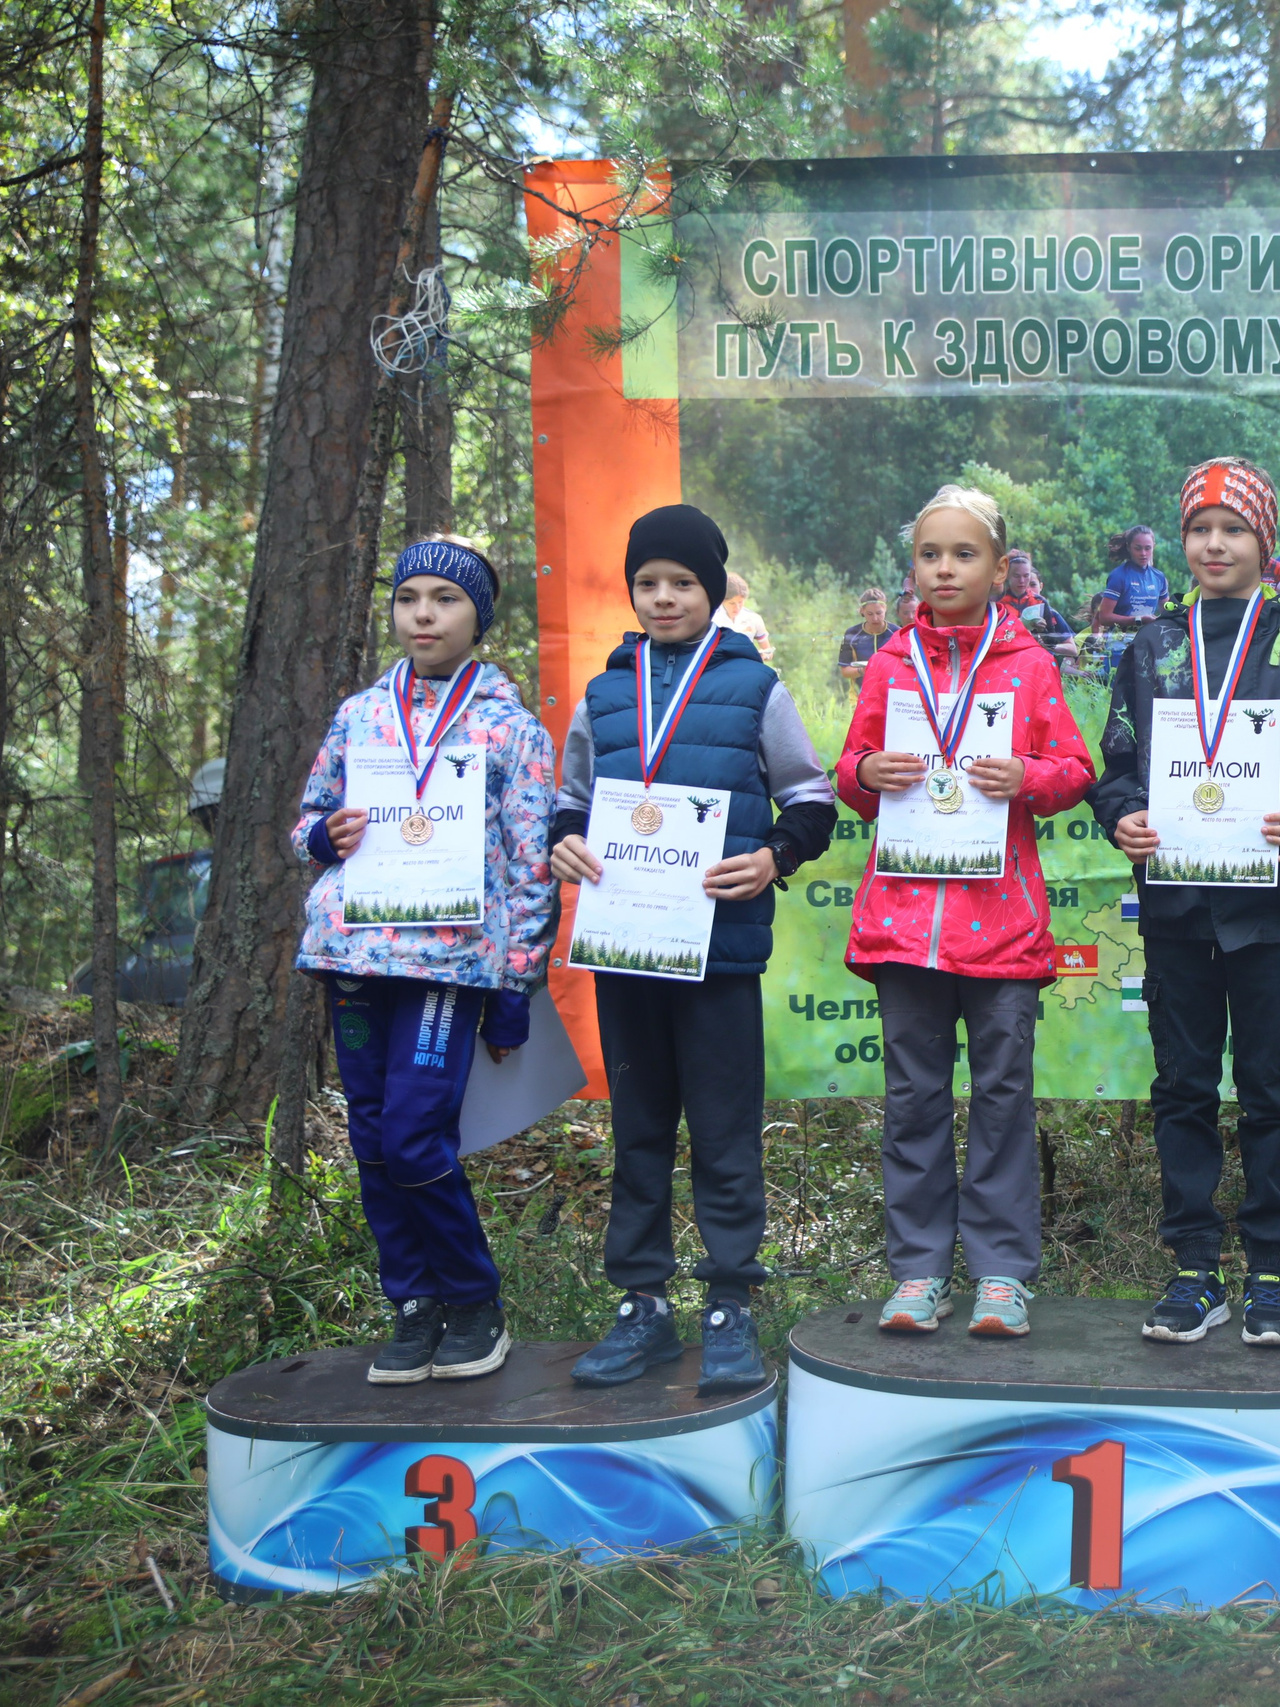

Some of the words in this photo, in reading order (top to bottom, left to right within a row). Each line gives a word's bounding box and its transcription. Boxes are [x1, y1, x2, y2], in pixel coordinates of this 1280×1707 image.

[743, 235, 1142, 296] СПОРТИВНОЕ
[714, 321, 862, 378] ПУТЬ
[882, 320, 917, 377] К
[604, 842, 700, 868] ДИПЛОМ
[417, 990, 439, 1050] СПОРТИВНОЕ
[413, 1051, 445, 1069] ЮГРА
[405, 1453, 478, 1571] 3
[1052, 1438, 1126, 1590] 1
